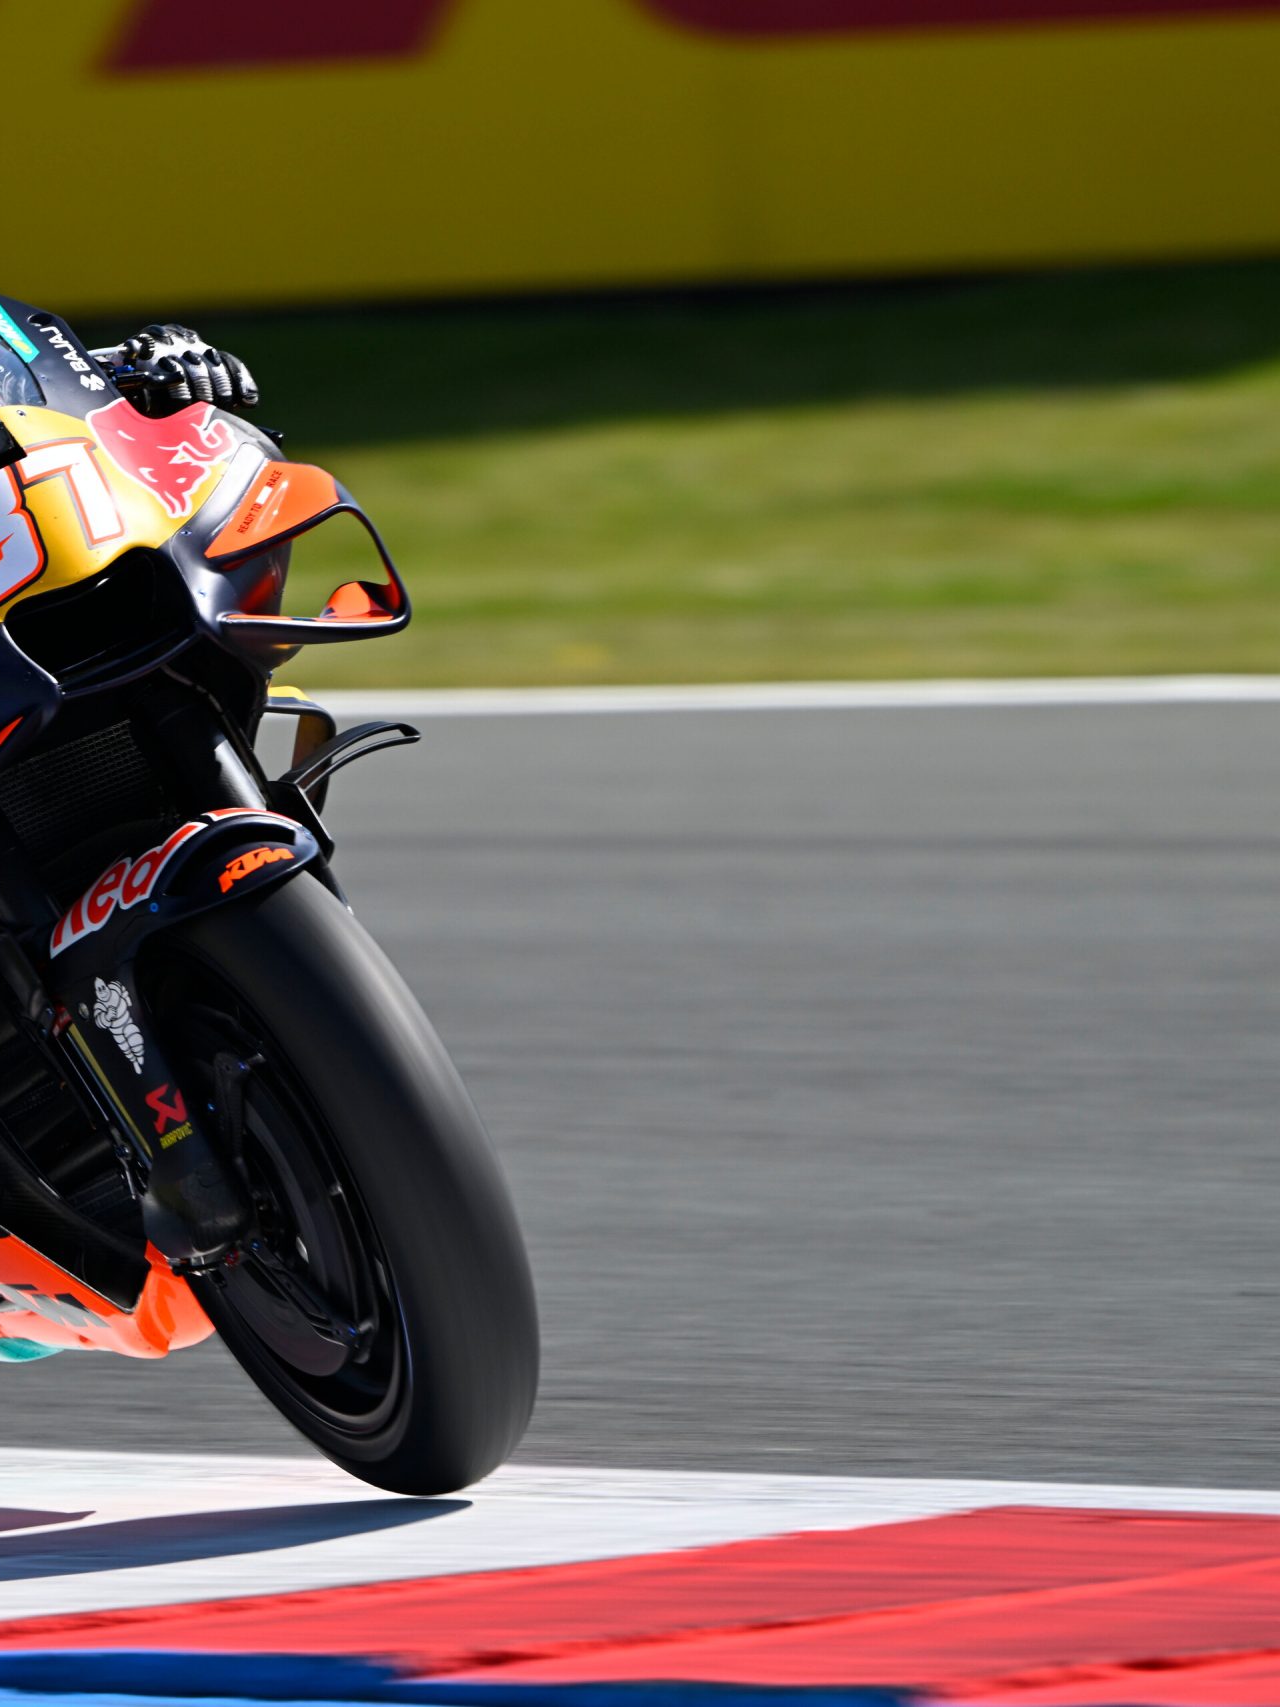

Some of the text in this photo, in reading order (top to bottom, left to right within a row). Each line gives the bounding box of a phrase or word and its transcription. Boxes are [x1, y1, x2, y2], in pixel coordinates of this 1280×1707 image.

[39, 326, 91, 372] BAJAJ
[237, 470, 283, 534] READY TO RACE
[218, 846, 295, 894] KTM
